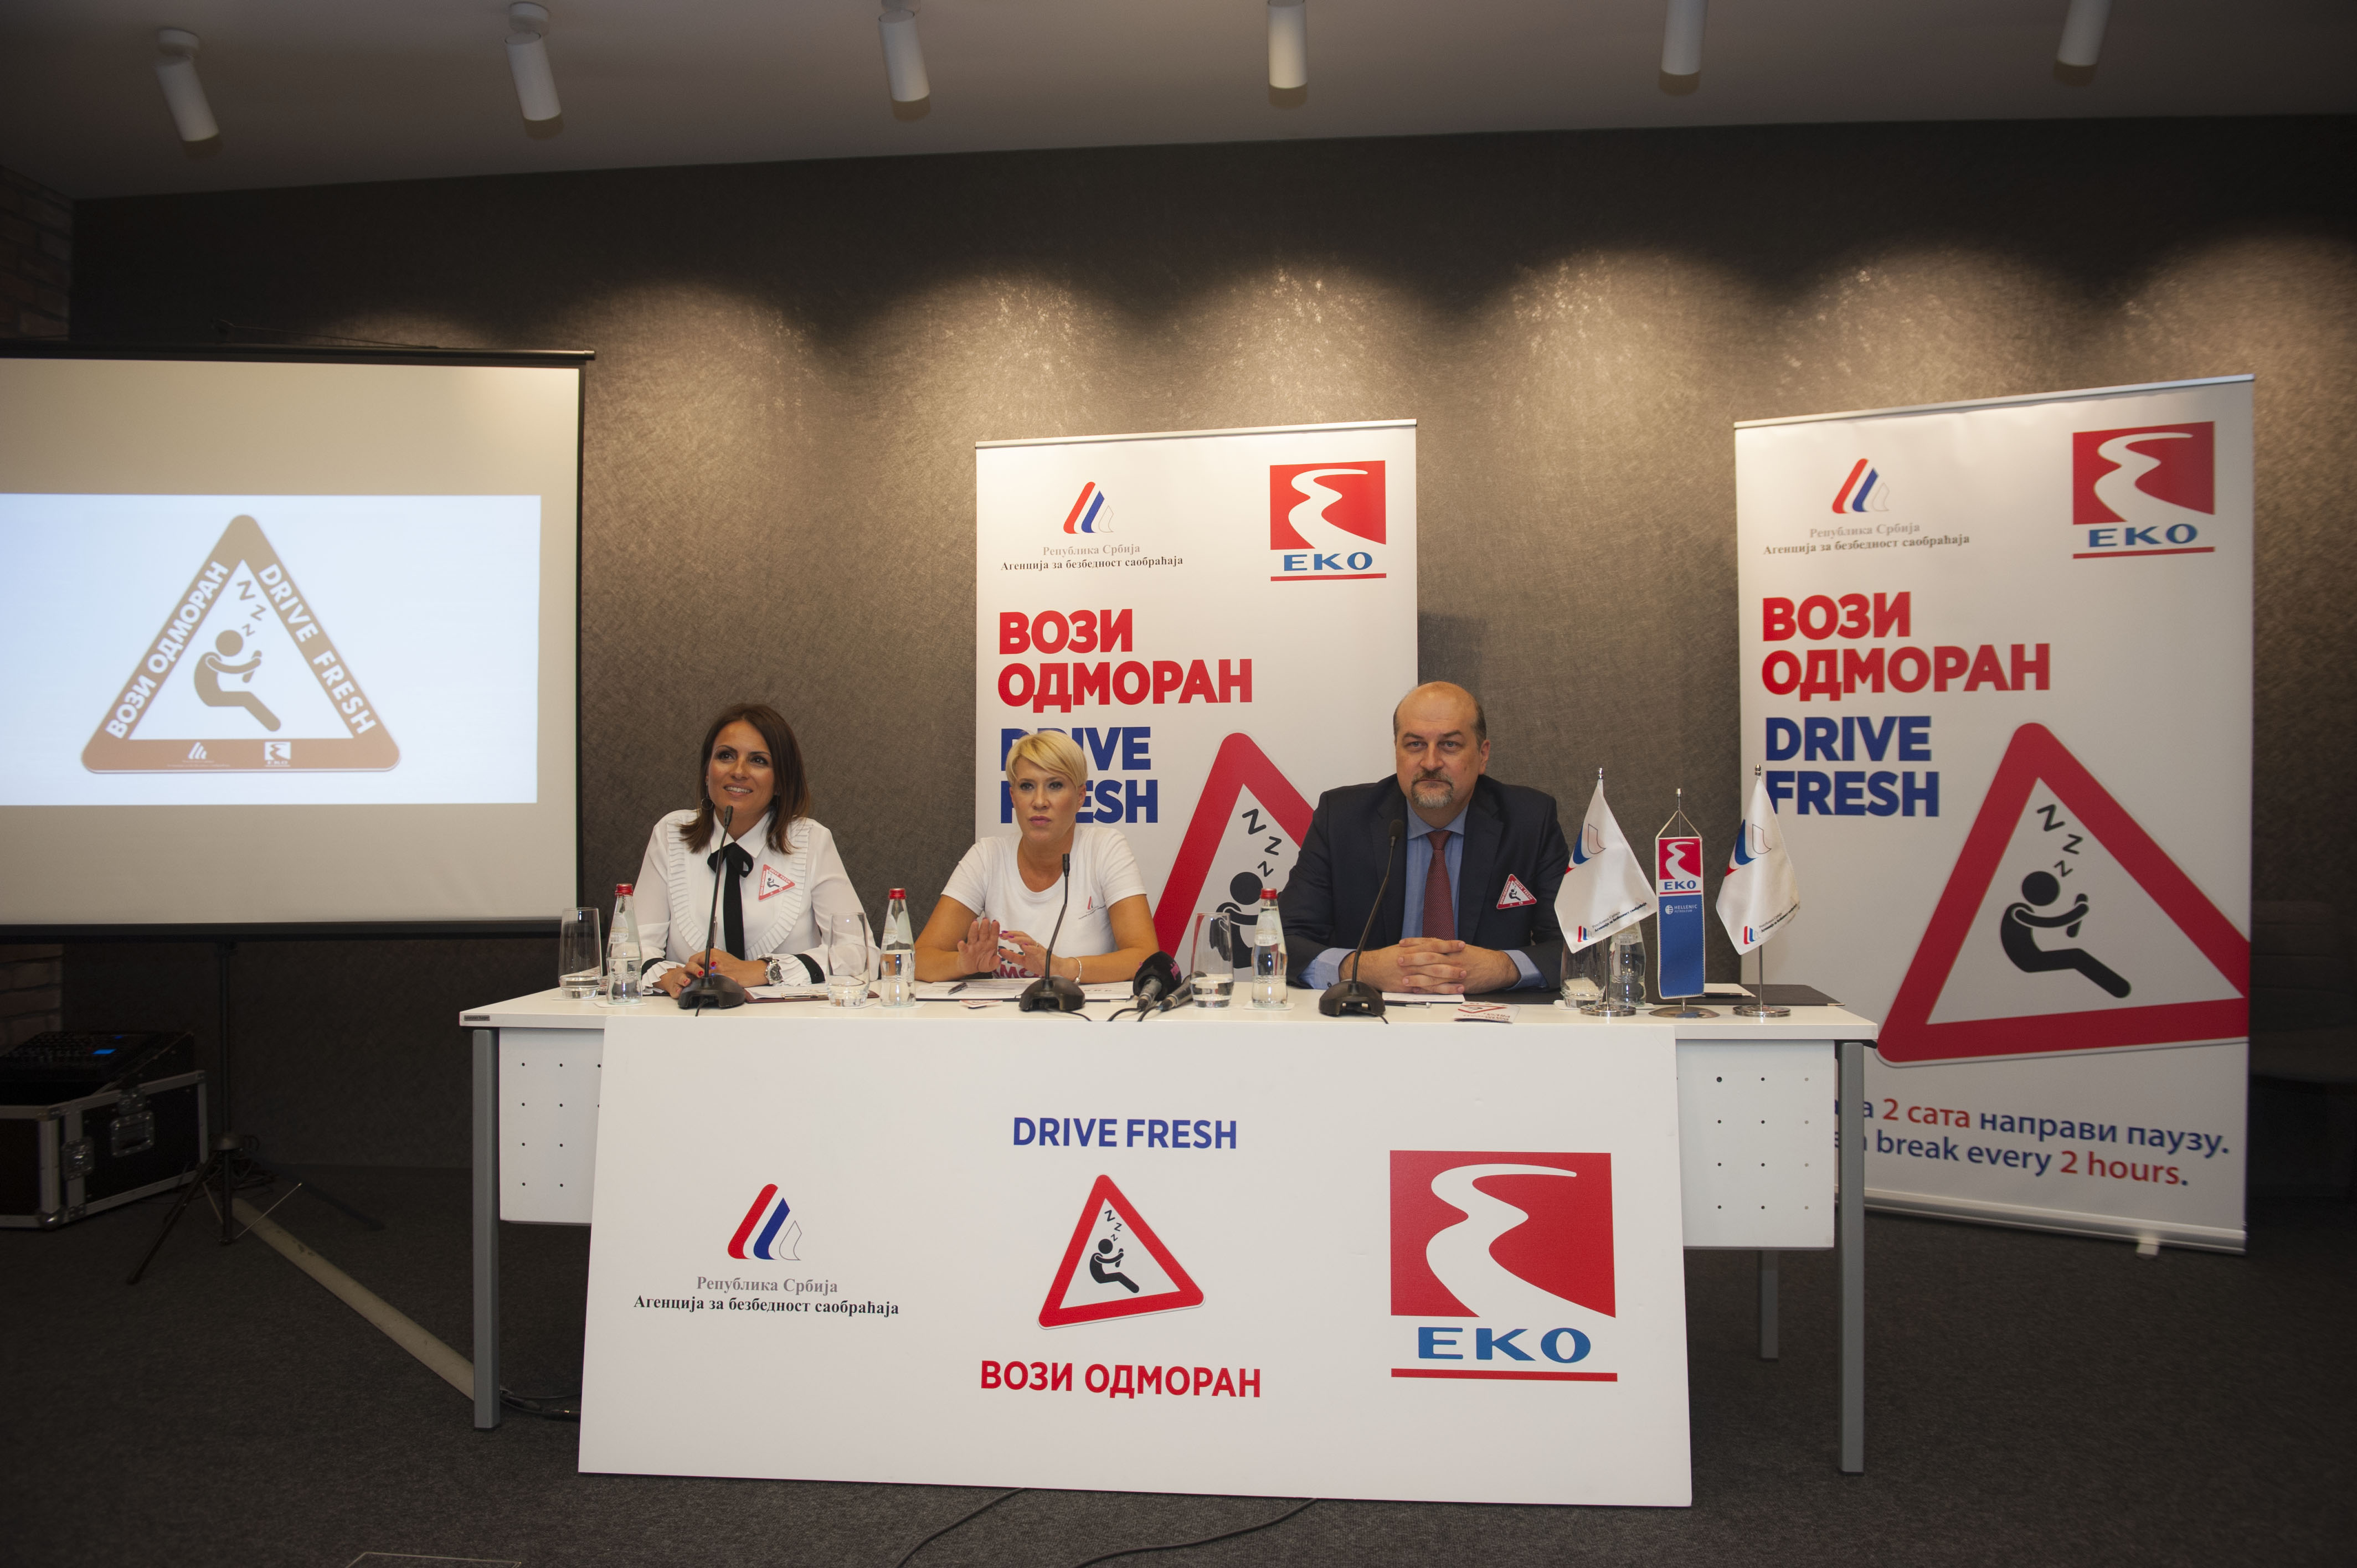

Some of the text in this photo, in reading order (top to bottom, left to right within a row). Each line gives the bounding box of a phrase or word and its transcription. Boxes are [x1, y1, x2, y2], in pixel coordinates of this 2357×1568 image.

[1042, 543, 1141, 558] Република Србија
[1763, 534, 1970, 555] Агенција за безбедност саобраћаја
[1809, 522, 1921, 539] Република Србија
[1000, 555, 1184, 572] Агенција за безбедност саобраћаја
[999, 608, 1133, 655] ВОЗИ
[1762, 591, 1911, 642] ВОЗИ
[105, 561, 229, 739] ВОЗИ ОДМОРАН
[259, 564, 377, 734] DRIVE FRESH
[997, 658, 1253, 714] ОДМОРАН
[1761, 643, 2050, 702] ОДМОРАН
[1766, 716, 1931, 761] DRIVE
[1766, 771, 1939, 817] FRESH
[1012, 1117, 1237, 1150] DRIVE FRESH
[1882, 1098, 1899, 1121] 2
[1907, 1104, 1971, 1128] сата
[1980, 1111, 2118, 1144] направи
[2127, 1125, 2230, 1158] паузу.
[1876, 1128, 1959, 1162] break
[1967, 1146, 2052, 1176] every
[2060, 1149, 2078, 1174] 2
[2088, 1151, 2189, 1186] hours.
[633, 1294, 899, 1318] Агенција за безбедност саобраћаја
[696, 1276, 838, 1296] Република Србија
[980, 1360, 1261, 1400] ВОЗИ ОДМОРАН
